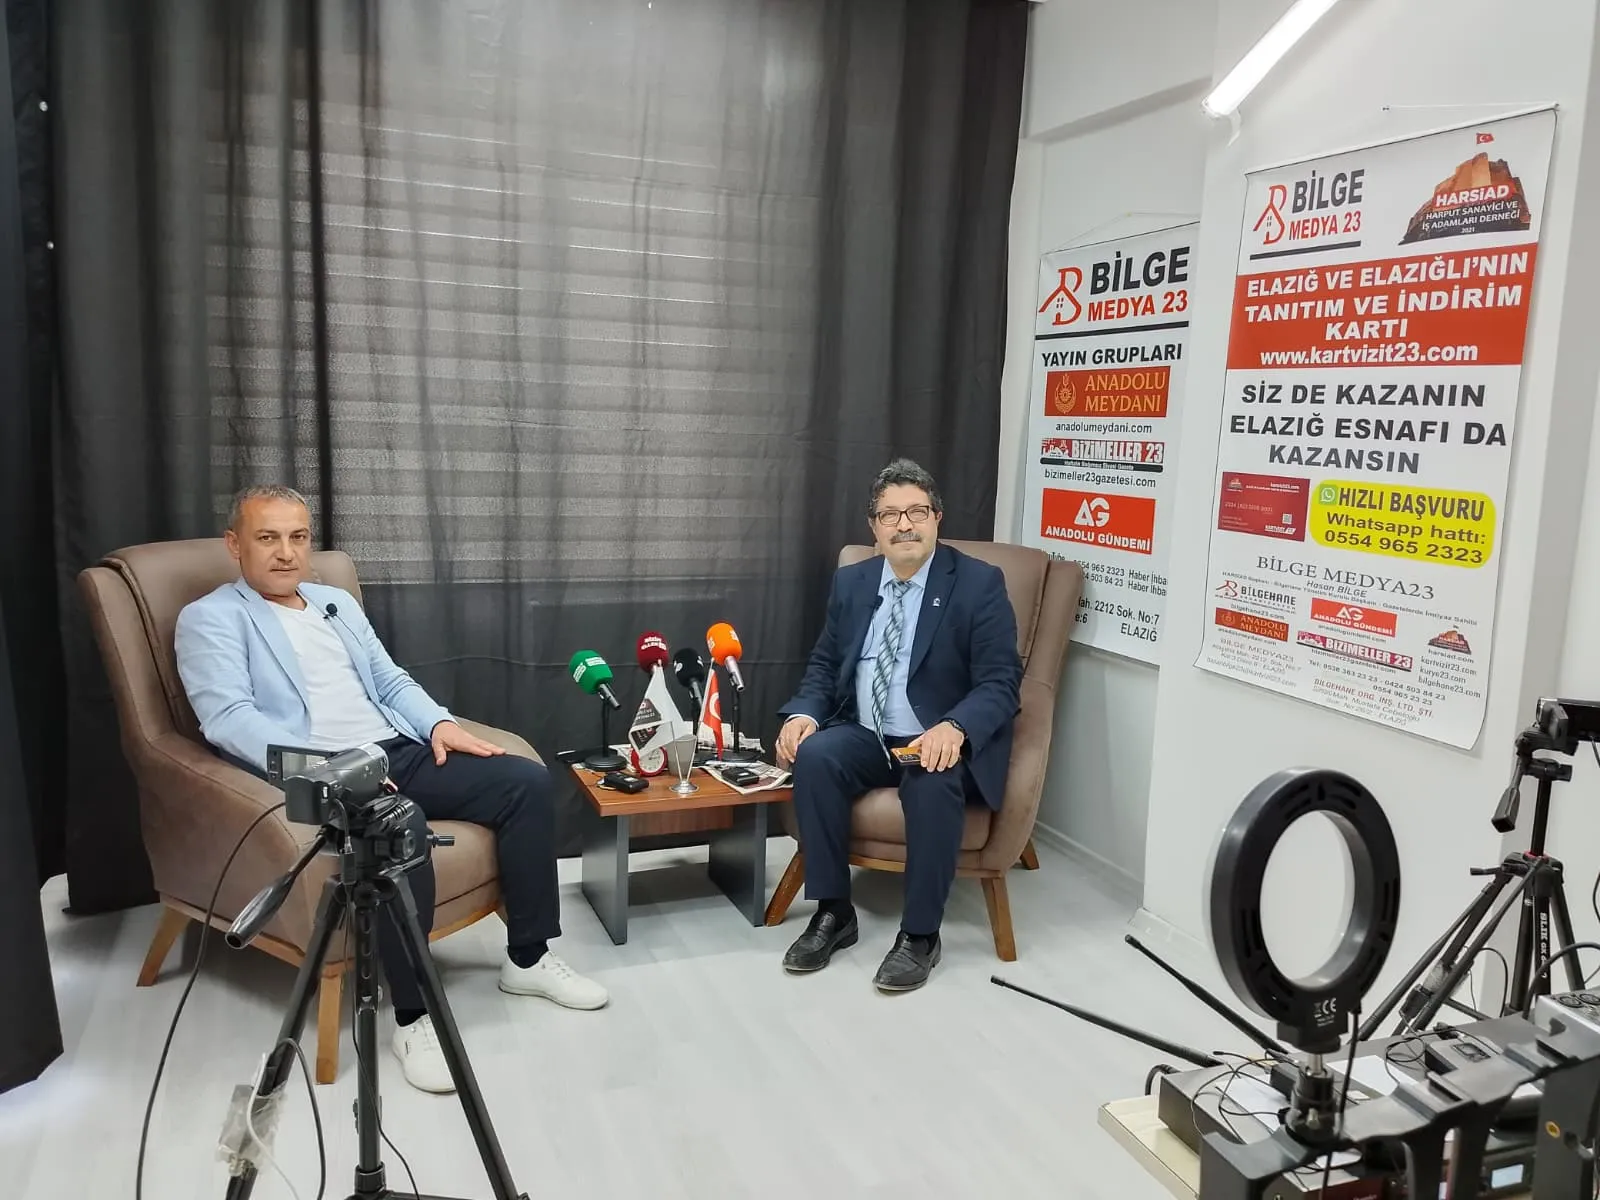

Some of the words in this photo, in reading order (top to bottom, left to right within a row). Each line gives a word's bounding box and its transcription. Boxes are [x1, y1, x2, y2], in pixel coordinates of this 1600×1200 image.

[1291, 169, 1365, 213] BİLGE
[1426, 209, 1460, 220] HARPUT
[1461, 202, 1504, 215] SANAYİCİ
[1506, 200, 1518, 209] VE
[1431, 217, 1477, 229] ADAMLARI
[1479, 209, 1520, 223] DERNEĞİ
[1289, 215, 1338, 241] MEDYA
[1343, 210, 1361, 233] 23
[1090, 246, 1190, 295] BİLGE
[1247, 272, 1319, 298] ELAZIĞ
[1325, 269, 1353, 290] VE
[1088, 295, 1155, 322] MEDYA
[1162, 290, 1188, 314] 23
[1244, 297, 1344, 323] TANITIM
[1353, 294, 1388, 315] VE
[1397, 282, 1522, 313] İNDİRİM
[1325, 318, 1408, 340] KARTI
[1042, 351, 1087, 367] YAYIN
[1092, 343, 1182, 365] GRUPLARI
[1260, 343, 1478, 365] www.kartvizit23.com
[1084, 372, 1166, 392] ANADOLU
[1084, 395, 1160, 412] MEYDANI
[1241, 380, 1283, 404] SİZ
[1291, 384, 1326, 405] DE
[1335, 384, 1486, 407] KAZANIN
[1055, 421, 1153, 435] anadolumeydani.com
[1230, 412, 1324, 437] ELAZIĞ
[1335, 418, 1449, 444] ESNAFI
[1463, 422, 1507, 446] DA
[1145, 443, 1163, 463] 23
[1269, 444, 1419, 474] KAZANSIN
[1045, 469, 1156, 488] bizimeller23gazetesi.com
[1074, 497, 1110, 527] AG
[1339, 487, 1384, 511] HIZLI
[1389, 492, 1485, 522] BAŞVURU
[1045, 525, 1095, 542] ANADOLU
[1097, 533, 1150, 551] GÜNDEMİ
[1326, 512, 1423, 539] Whatsapp
[1430, 524, 1486, 545] hattı:
[1325, 530, 1372, 548] 0554
[1379, 536, 1418, 554] 965
[1426, 543, 1483, 564] 2323
[1091, 563, 1105, 573] 965
[1106, 566, 1125, 577] 2323
[1129, 569, 1149, 582] Haber
[1091, 573, 1102, 582] 503
[1104, 576, 1113, 585] 84
[1114, 577, 1124, 587] 23
[1128, 581, 1149, 593] Haber
[1256, 555, 1317, 578] BİLGE
[1324, 567, 1435, 600] MEDYA23
[1307, 580, 1335, 591] Hasan
[1337, 586, 1367, 598] BİLGE
[1095, 600, 1114, 615] 2212
[1117, 605, 1135, 620] Sok.
[1138, 609, 1160, 625] No:7
[1240, 615, 1286, 631] ANADOLU
[1313, 613, 1351, 625] ANADOLU
[1336, 606, 1364, 621] AG
[1121, 623, 1158, 642] ELAZIĞ
[1240, 623, 1285, 640] MEYDANI
[1395, 655, 1411, 669] 23
[1421, 656, 1477, 675] kartvizit23.com
[1420, 666, 1466, 684] kurye23.com
[1373, 685, 1391, 694] 0554
[1410, 695, 1420, 703] 23
[1421, 698, 1433, 706] 23
[1384, 680, 1403, 689] 0424
[1406, 685, 1421, 694] 503
[1418, 676, 1481, 698] bilgehane23.com
